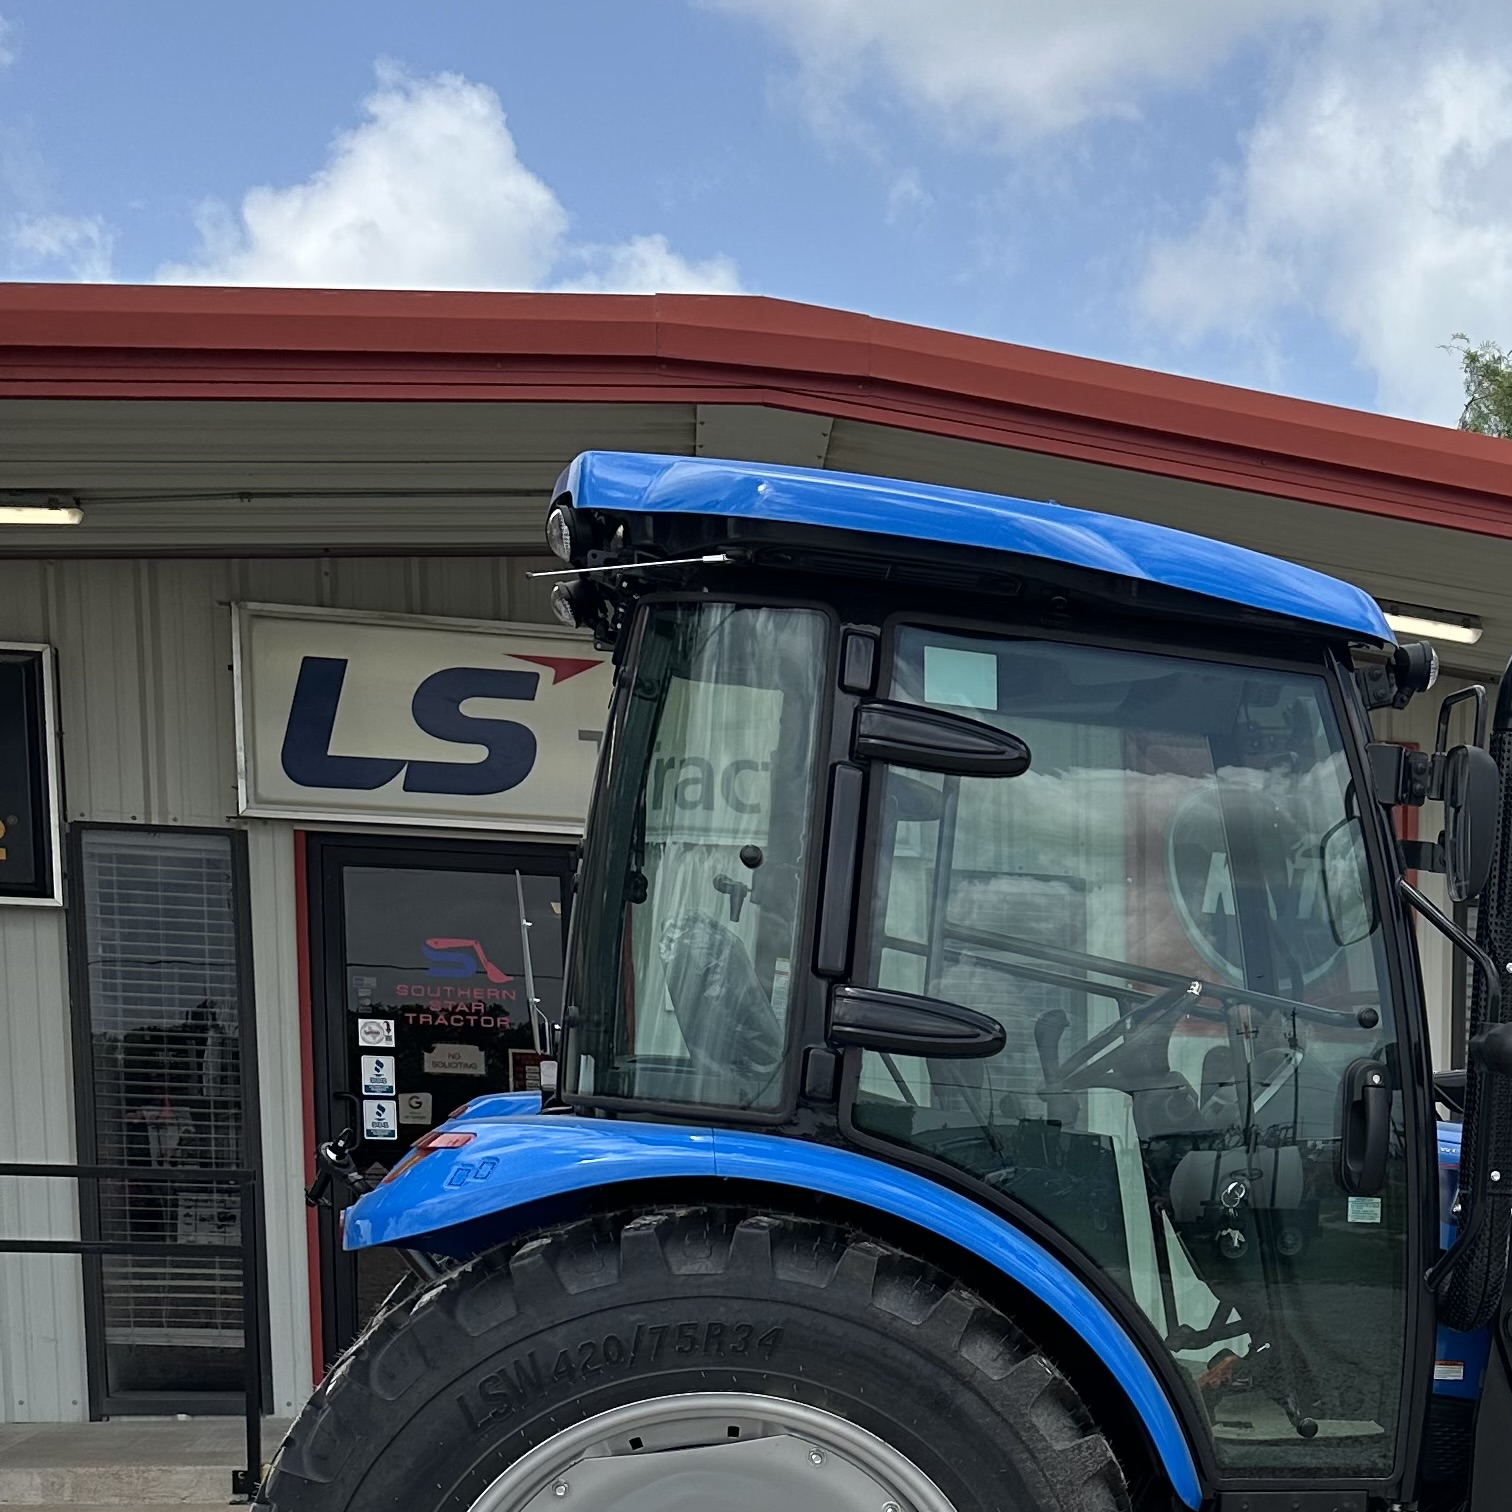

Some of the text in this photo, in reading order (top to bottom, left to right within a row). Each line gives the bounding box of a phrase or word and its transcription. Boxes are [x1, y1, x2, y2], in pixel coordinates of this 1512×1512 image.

[281, 656, 539, 795] LS
[396, 984, 517, 1001] SOUTHERN
[429, 1001, 485, 1014] STAR
[404, 1013, 512, 1029] TRACTOR
[447, 1052, 461, 1060] NO
[431, 1060, 478, 1070] SOLICITING
